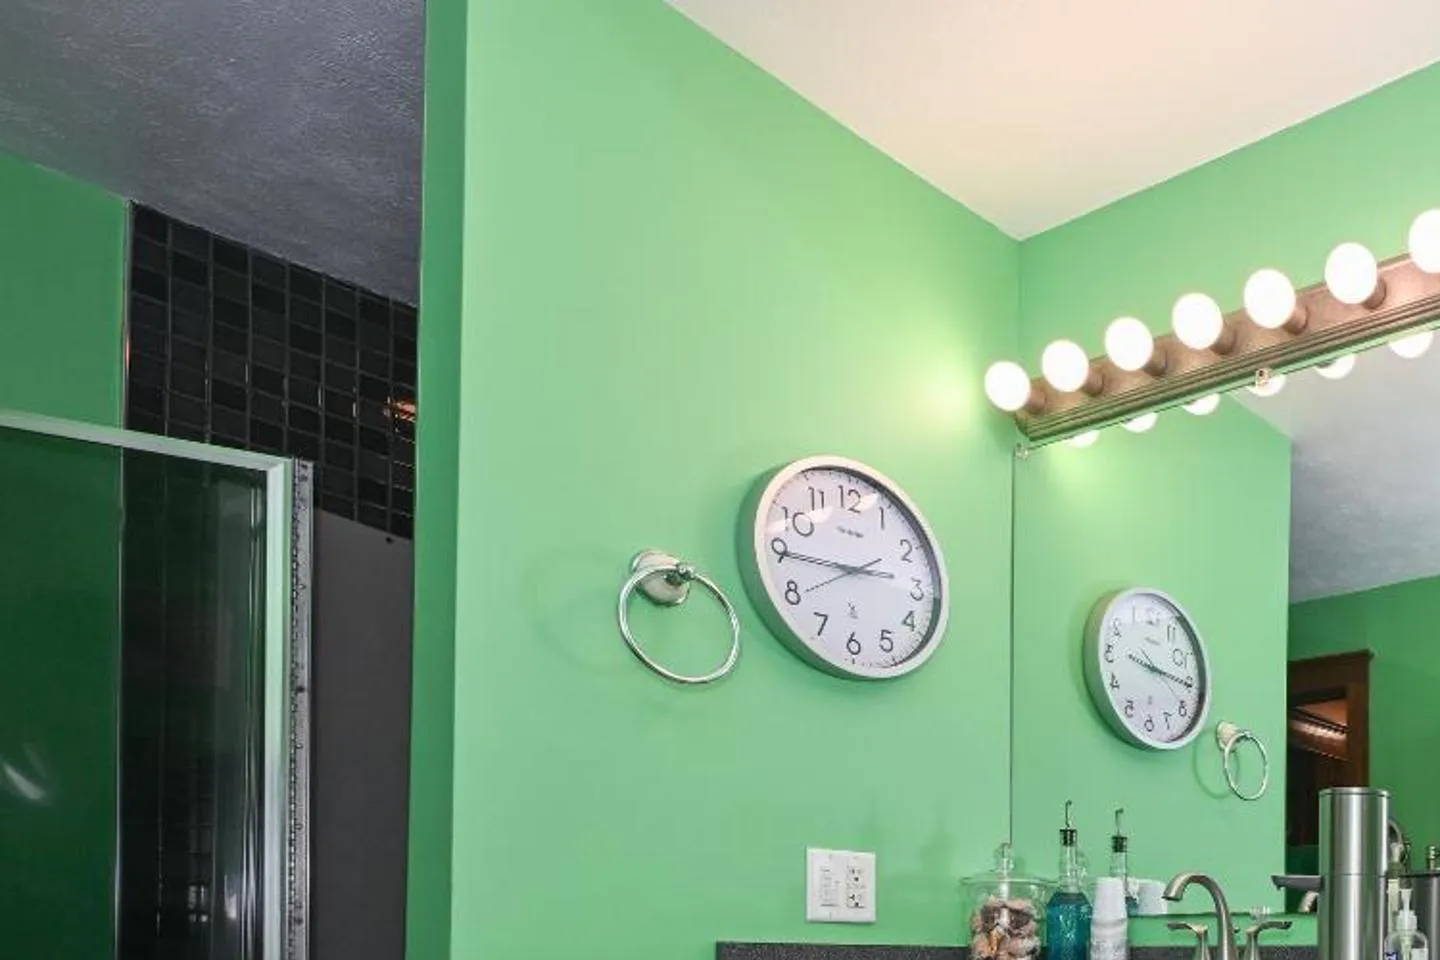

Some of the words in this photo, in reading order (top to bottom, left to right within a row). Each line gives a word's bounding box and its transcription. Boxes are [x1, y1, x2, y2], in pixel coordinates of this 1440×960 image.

[808, 487, 825, 511] 11
[838, 485, 862, 513] 12
[782, 506, 815, 537] 10
[879, 507, 886, 530] 1
[771, 537, 788, 563] 9
[899, 539, 913, 563] 2
[784, 580, 801, 605] 8
[910, 578, 925, 601] 3
[813, 611, 828, 636] 7
[902, 610, 916, 631] 4
[846, 632, 862, 655] 6
[879, 630, 894, 652] 5
